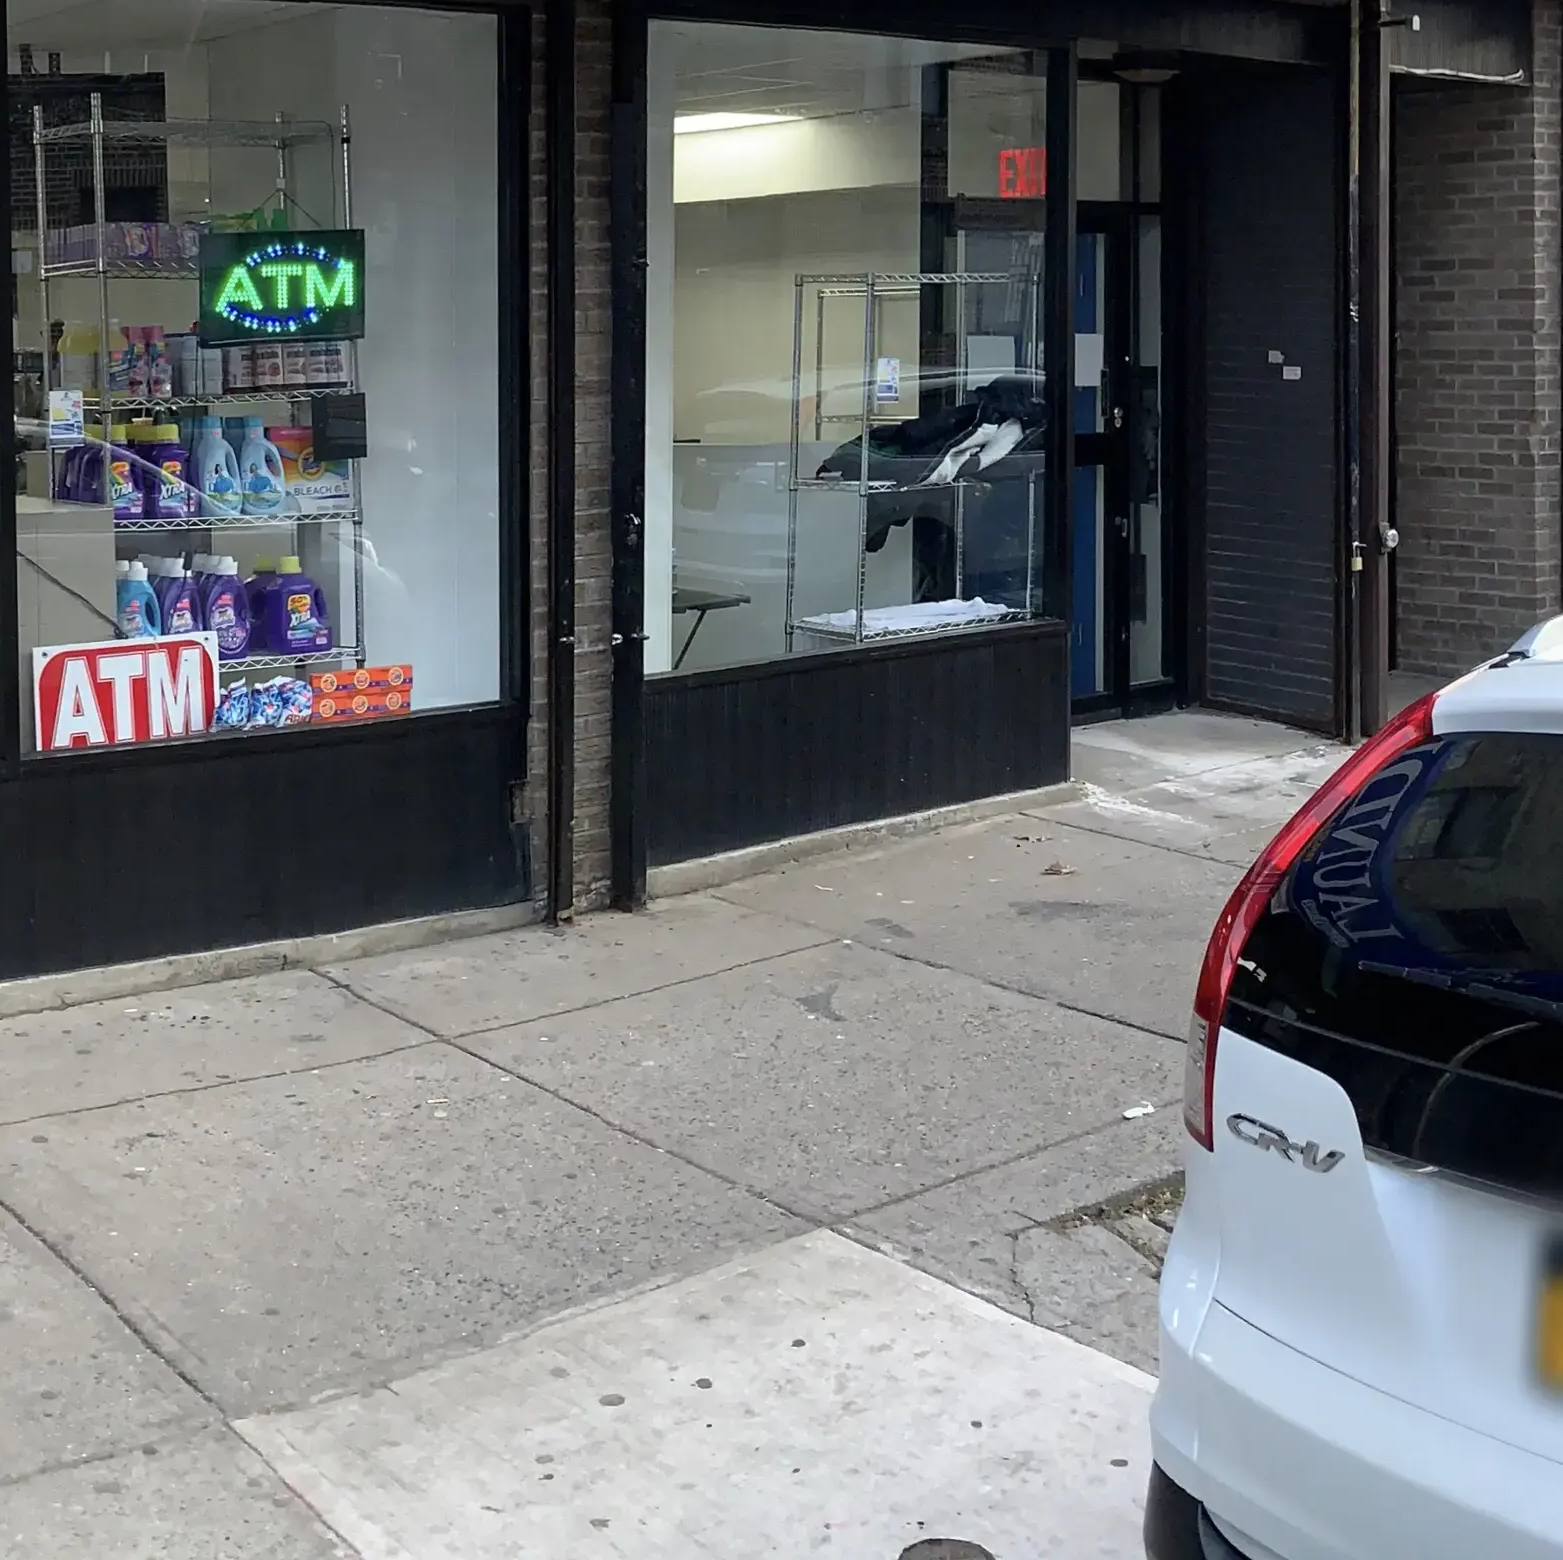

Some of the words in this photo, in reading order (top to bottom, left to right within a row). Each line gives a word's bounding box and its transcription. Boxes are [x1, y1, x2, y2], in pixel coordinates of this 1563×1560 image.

[999, 148, 1046, 198] EXI
[215, 259, 354, 311] ATM
[294, 484, 333, 496] BLEACH
[51, 645, 207, 750] ATM
[1226, 1112, 1346, 1173] CR-V
